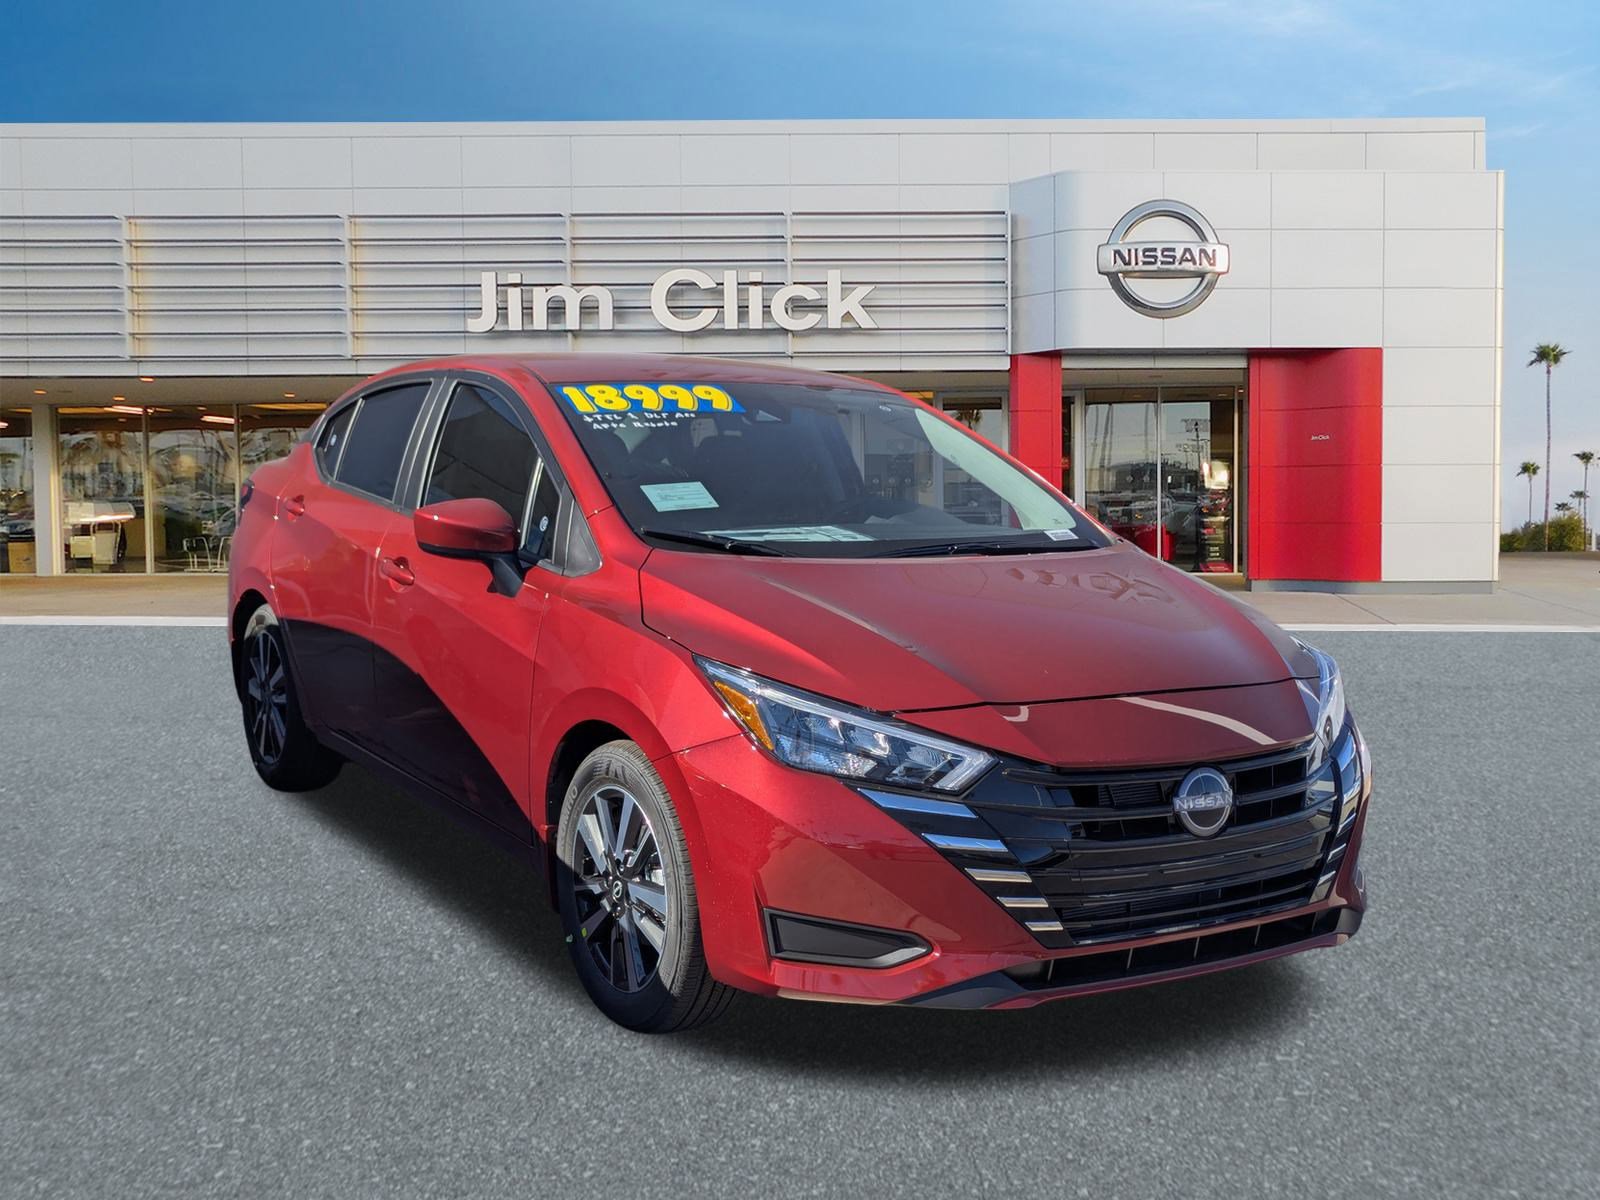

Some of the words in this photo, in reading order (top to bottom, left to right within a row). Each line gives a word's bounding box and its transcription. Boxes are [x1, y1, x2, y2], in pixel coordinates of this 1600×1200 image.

[1112, 247, 1217, 266] NISSAN
[467, 270, 614, 333] Jim
[650, 268, 880, 333] Click
[562, 384, 733, 413] 18999
[1175, 793, 1233, 810] NISSAN
